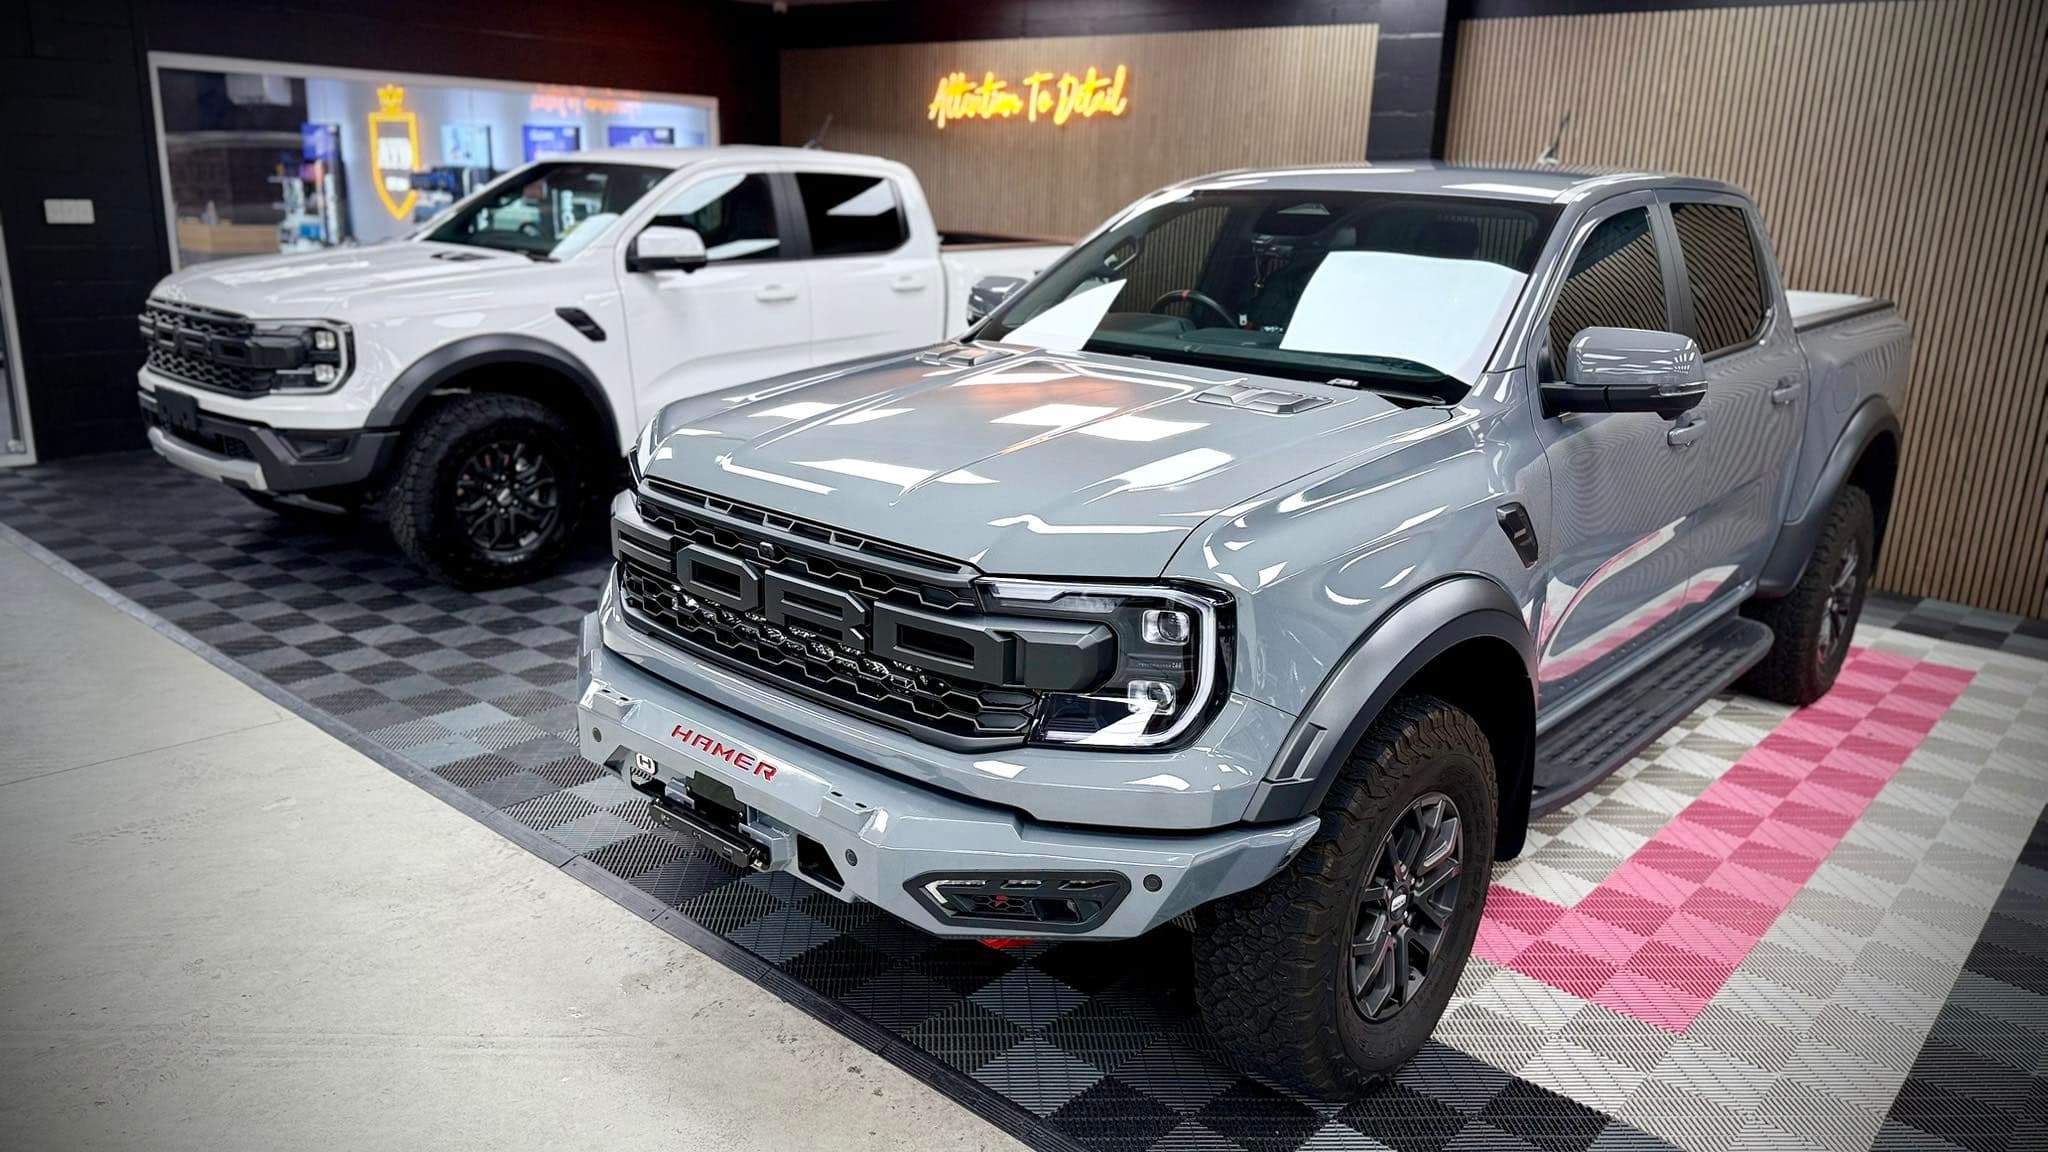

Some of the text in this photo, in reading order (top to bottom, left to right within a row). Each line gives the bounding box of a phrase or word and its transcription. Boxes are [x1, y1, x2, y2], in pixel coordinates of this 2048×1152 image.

[928, 64, 1128, 129] Attention To Detail
[138, 314, 256, 368] FORD
[611, 512, 1014, 686] FORD
[671, 724, 778, 782] HAMER
